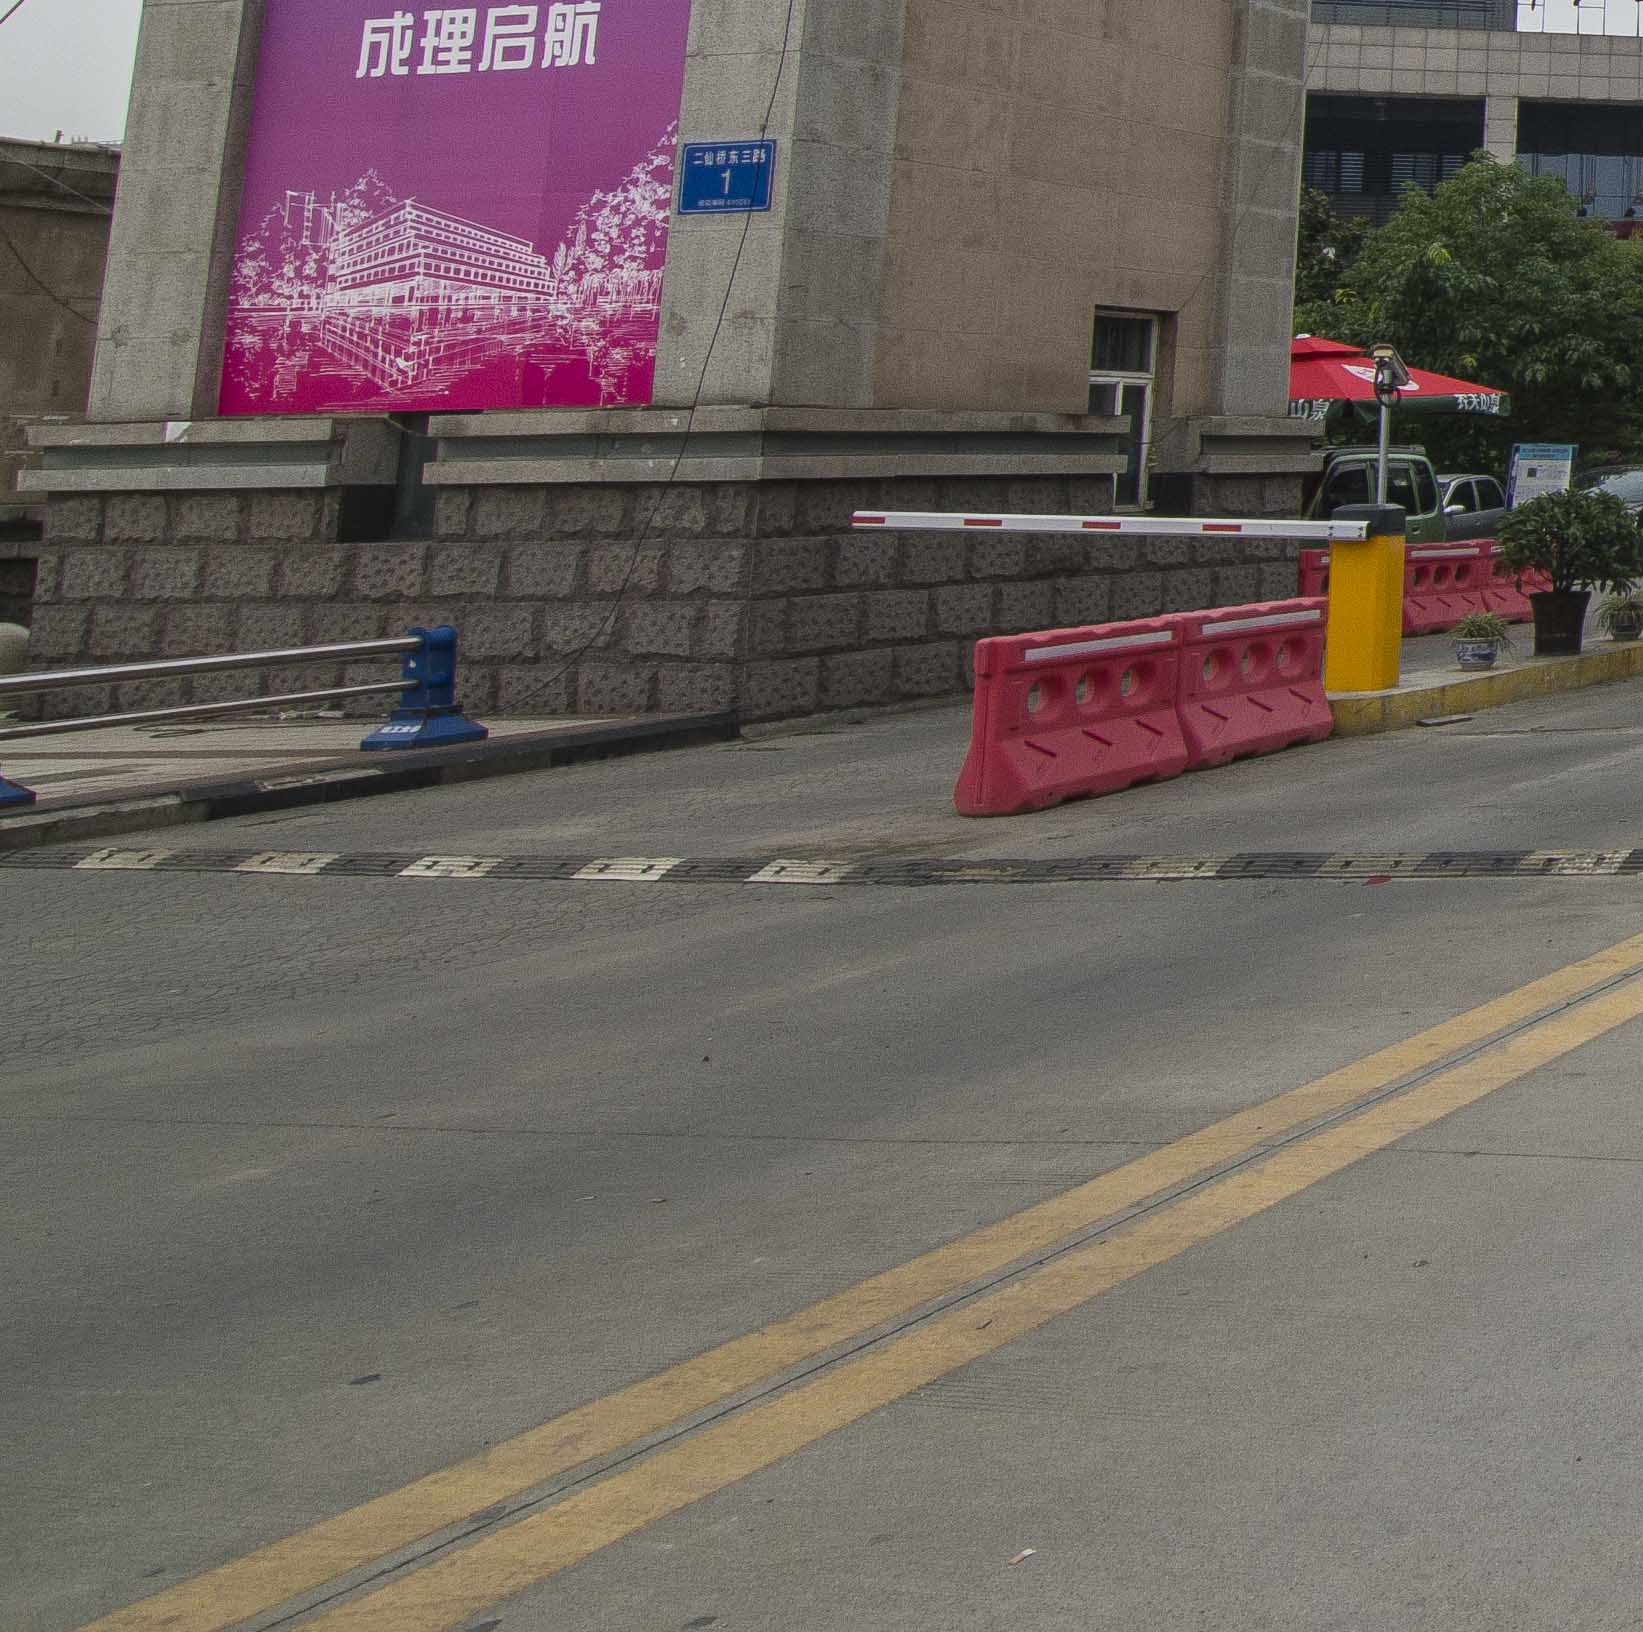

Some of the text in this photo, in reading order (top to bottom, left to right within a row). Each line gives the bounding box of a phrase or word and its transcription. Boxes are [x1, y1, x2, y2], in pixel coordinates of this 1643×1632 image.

[356, 0, 601, 78] 成理启航
[693, 149, 766, 166] 二仙桥东三路
[721, 169, 731, 195] 1
